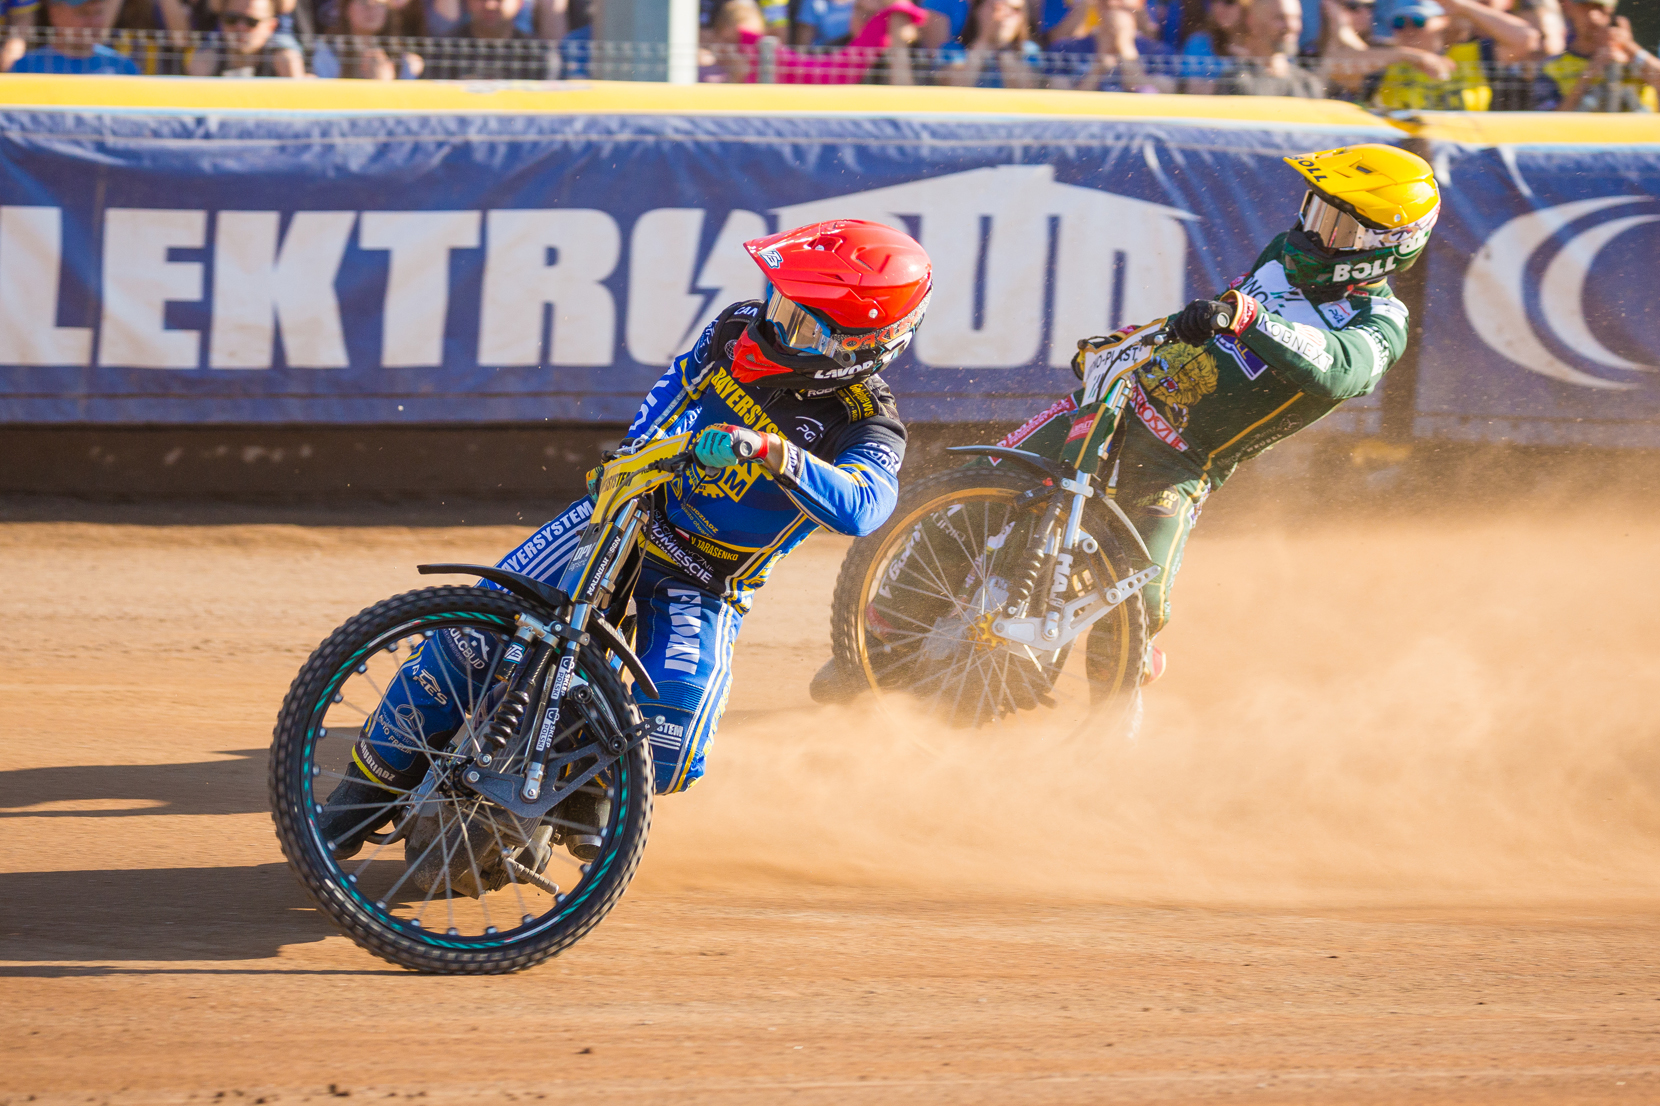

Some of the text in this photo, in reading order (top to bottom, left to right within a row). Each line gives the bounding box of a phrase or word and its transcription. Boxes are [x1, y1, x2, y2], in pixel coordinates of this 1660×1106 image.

[1332, 255, 1397, 282] BOLL
[841, 309, 920, 351] OAKLEY
[1257, 313, 1331, 371] KOBNEXT
[448, 627, 485, 670] ULCBUD
[537, 723, 549, 750] POLSKI
